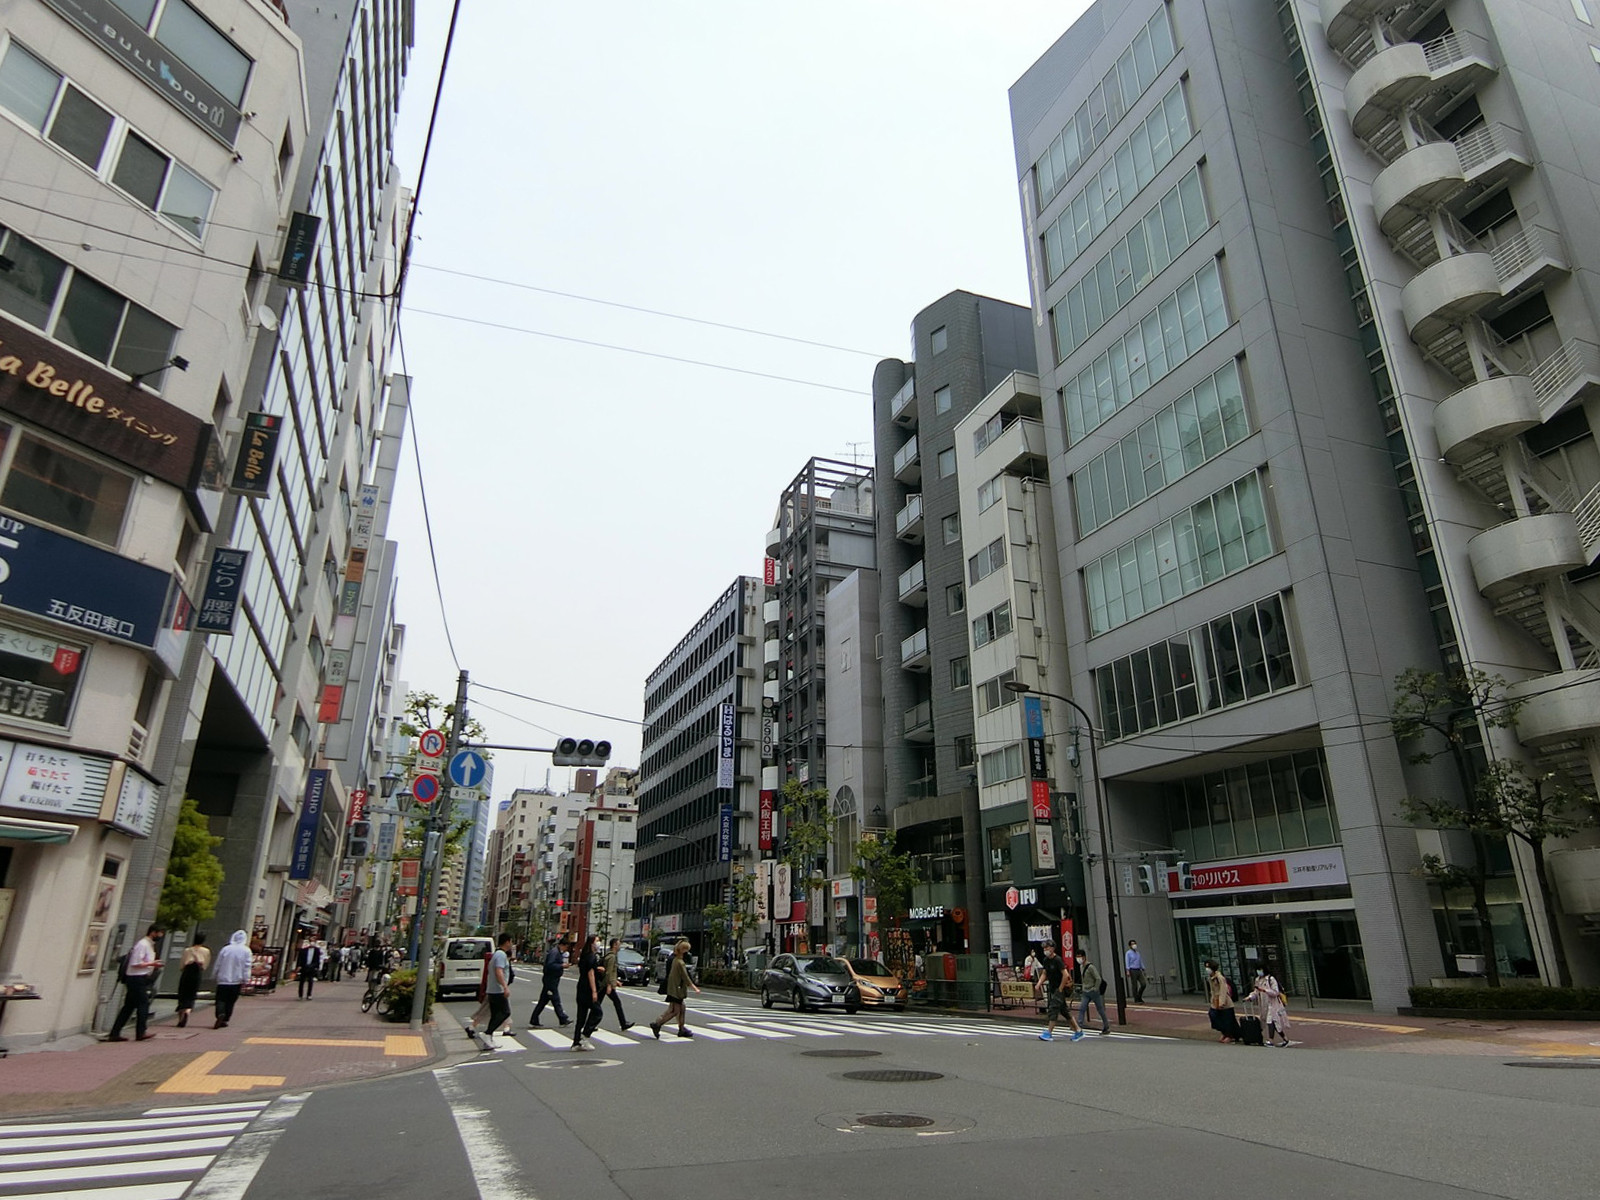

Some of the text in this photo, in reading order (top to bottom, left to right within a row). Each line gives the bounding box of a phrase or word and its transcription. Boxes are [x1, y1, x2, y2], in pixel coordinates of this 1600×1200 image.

[103, 23, 209, 115] BULL DOG
[26, 361, 105, 414] Belle
[106, 406, 178, 446] ダイニング
[251, 431, 269, 447] La
[244, 448, 265, 480] Belle
[46, 598, 135, 637] 五反田東口
[763, 718, 772, 753] 2900
[25, 751, 69, 767] 打ちたて
[309, 776, 324, 815] MIZUHO
[761, 798, 771, 841] 大阪王将
[1020, 888, 1036, 905] IFU
